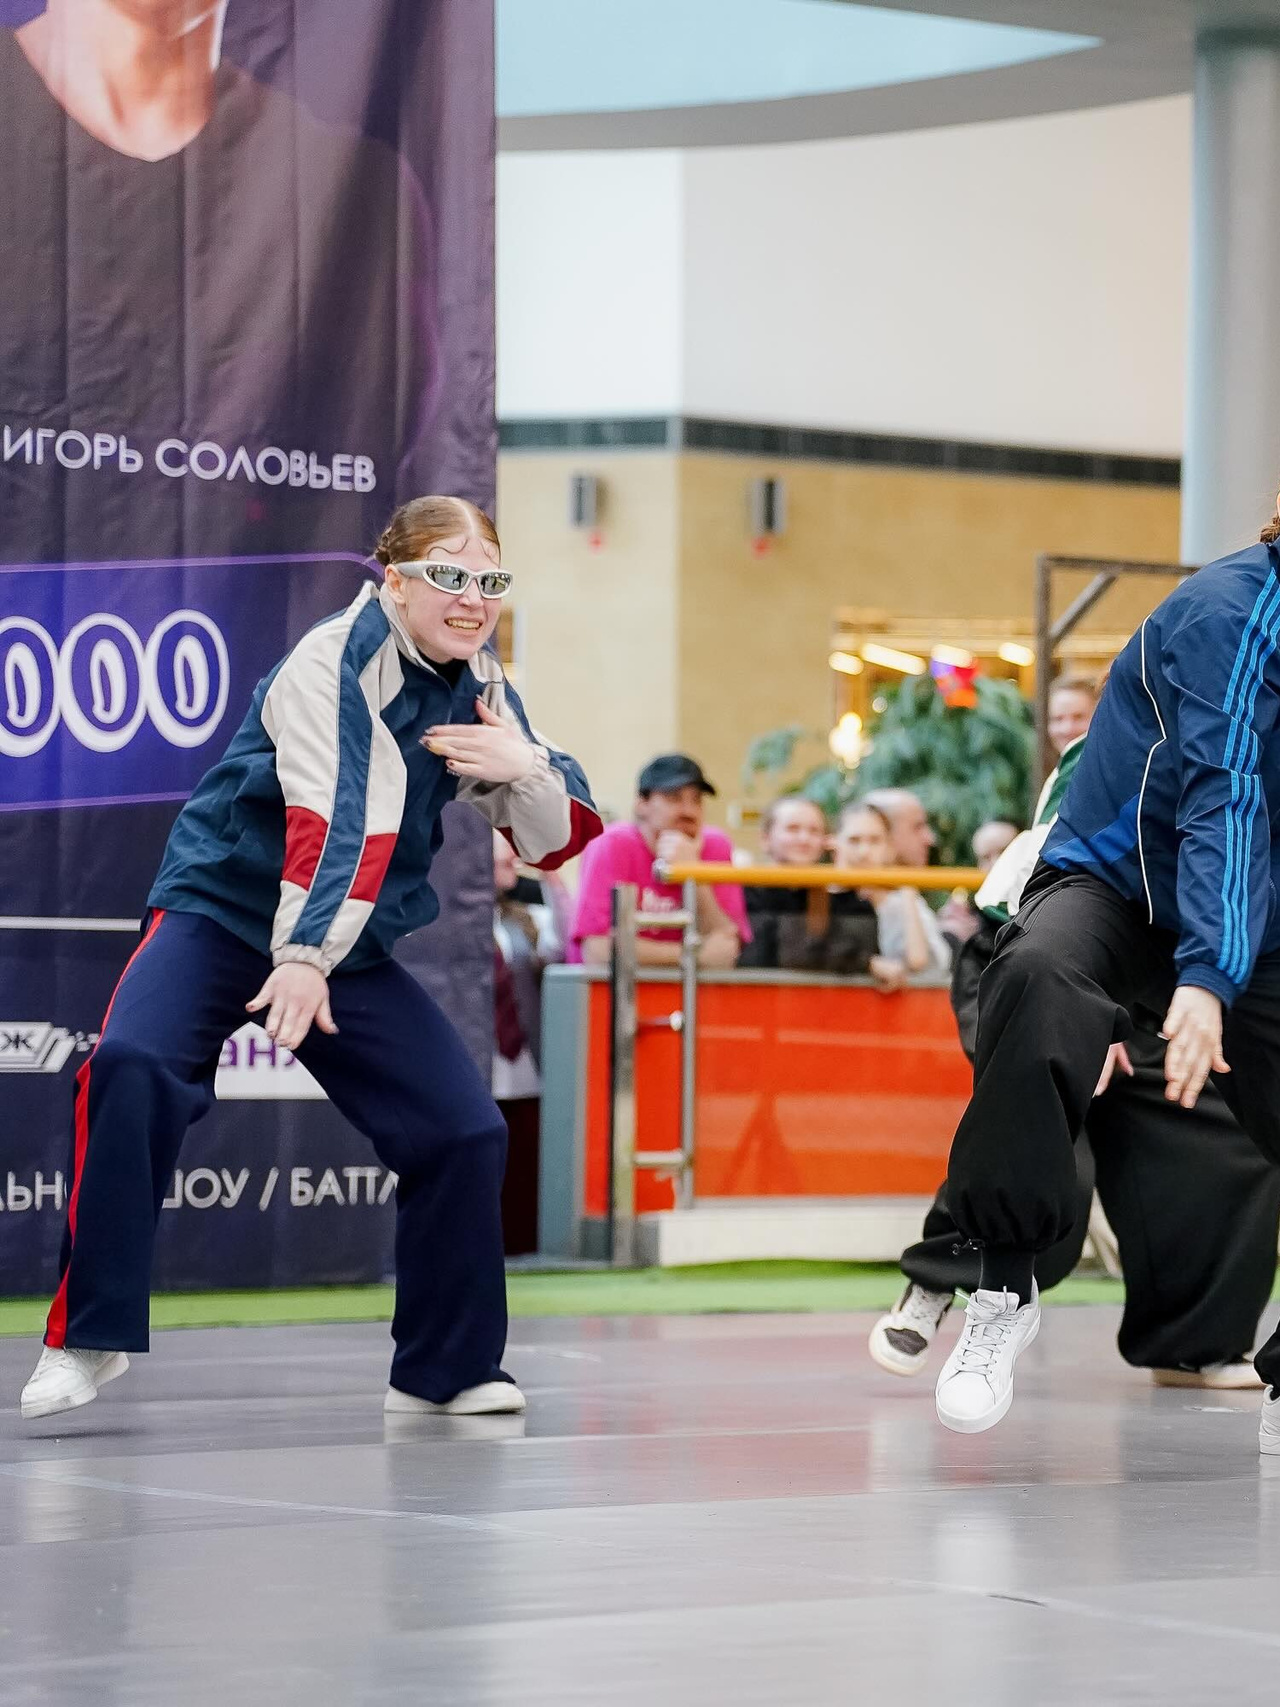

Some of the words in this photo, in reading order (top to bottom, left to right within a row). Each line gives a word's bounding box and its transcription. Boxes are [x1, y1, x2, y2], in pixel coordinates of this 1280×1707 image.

[3, 424, 144, 473] ИГОРЬ
[155, 438, 377, 493] СОЛОВЬЕВ
[219, 1038, 296, 1067] ан
[0, 1170, 67, 1211] ЬН
[259, 1167, 279, 1211] /
